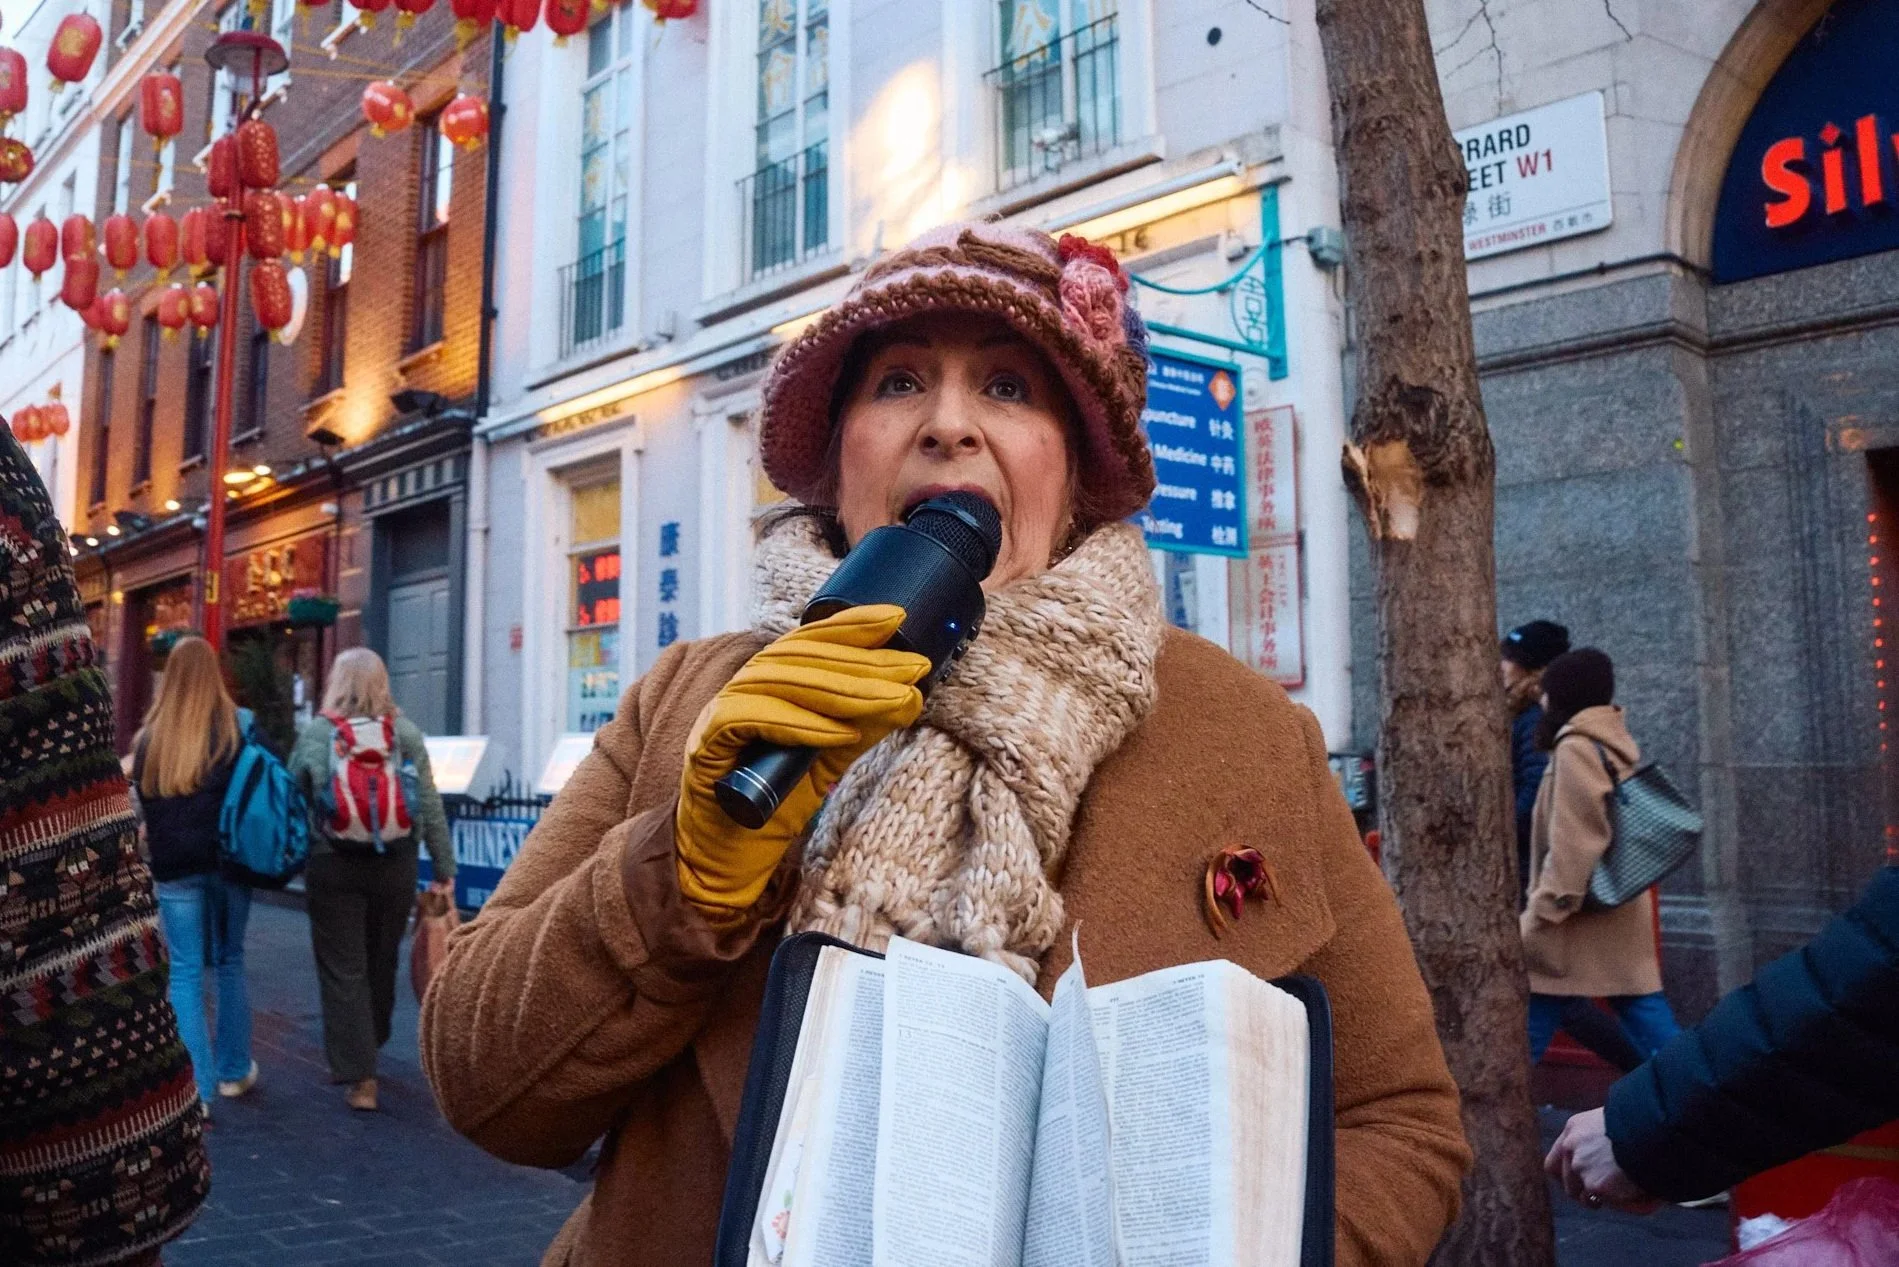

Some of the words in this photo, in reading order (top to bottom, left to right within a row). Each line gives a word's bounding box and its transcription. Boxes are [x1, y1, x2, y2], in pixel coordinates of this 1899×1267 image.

[1458, 123, 1531, 162] RARD
[1516, 148, 1554, 180] W1
[1468, 222, 1547, 251] WESTMINSTER
[1154, 443, 1208, 466] Medicine
